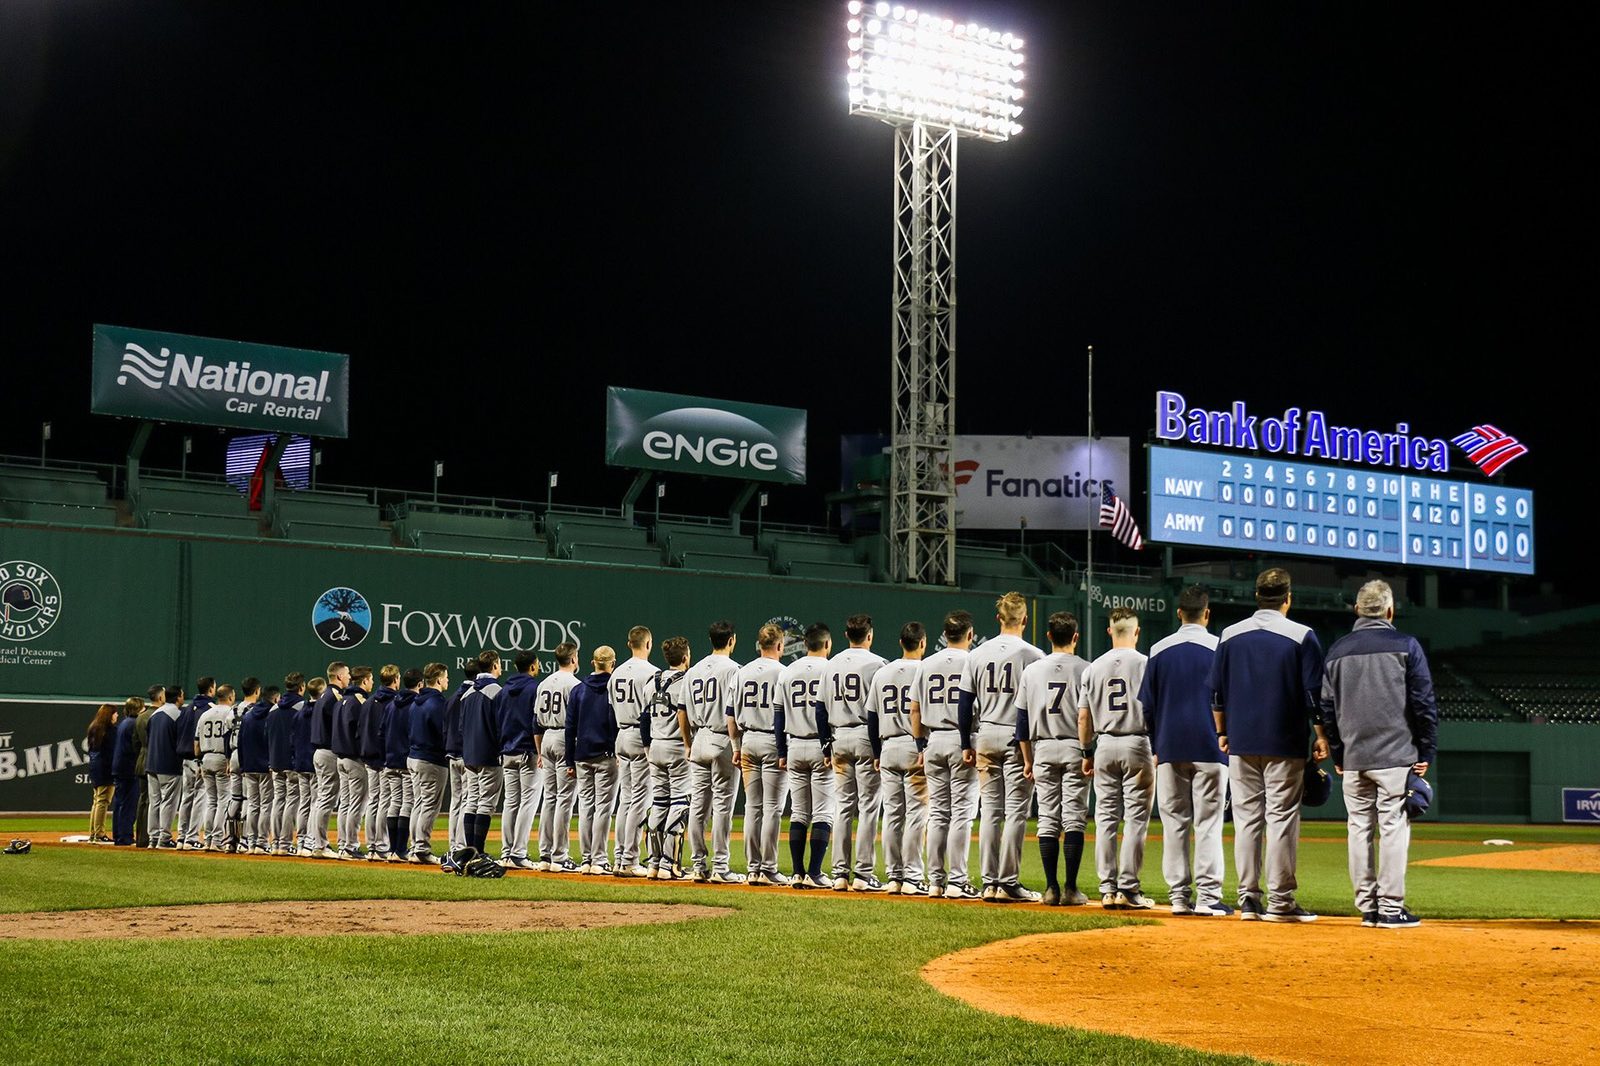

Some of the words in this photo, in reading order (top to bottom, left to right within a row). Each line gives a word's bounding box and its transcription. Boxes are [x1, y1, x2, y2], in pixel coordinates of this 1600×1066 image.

[169, 353, 329, 402] National
[225, 398, 258, 414] Car
[262, 401, 322, 421] Rental
[1156, 390, 1258, 449] Bank
[1261, 407, 1301, 455] of
[1303, 411, 1449, 473] America
[1222, 460, 1232, 477] 2
[1243, 463, 1253, 479] 3
[1264, 465, 1274, 482] 4
[1285, 467, 1294, 484] 5
[1306, 470, 1316, 486] 6
[1326, 472, 1336, 488] 7
[1346, 474, 1356, 491] 8
[1366, 476, 1376, 493] 9
[1383, 478, 1398, 495] 10
[1411, 481, 1421, 498] R
[1430, 483, 1440, 500] H
[1449, 485, 1459, 502] E
[1164, 477, 1203, 497] NAVY
[1222, 484, 1232, 501] 0
[1243, 486, 1253, 503] 0
[1264, 489, 1274, 506] 0
[1285, 491, 1295, 508] 0
[1308, 493, 1314, 510] 1
[1326, 495, 1336, 512] 2
[1347, 498, 1356, 514] 0
[1367, 500, 1376, 516] 0
[1412, 505, 1421, 521] 4
[1429, 507, 1442, 523] 12
[1450, 508, 1460, 525] 0
[1474, 493, 1486, 514] B
[1495, 495, 1507, 516] S
[1164, 512, 1205, 532] ARMY
[1222, 519, 1232, 536] 0
[1244, 521, 1254, 538] 0
[1265, 523, 1275, 540] 0
[1286, 525, 1295, 541] 0
[1307, 527, 1316, 543] 0
[1327, 529, 1337, 545] 0
[1347, 531, 1357, 547] 0
[1367, 533, 1377, 549] 0
[1412, 537, 1422, 553] 0
[1432, 539, 1441, 555] 3
[1452, 541, 1457, 557] 1
[1474, 528, 1486, 553] 0
[1495, 530, 1508, 555] 0
[1516, 533, 1529, 557] 0
[16, 564, 49, 586] SOX
[1102, 595, 1166, 613] ABIOMED
[380, 603, 582, 653] FOXWOODS
[21, 647, 66, 656] Deaconess
[22, 656, 53, 665] Center
[615, 678, 635, 703] 51
[692, 677, 717, 705] 20
[832, 673, 861, 702] 19
[928, 674, 962, 704] 22
[986, 662, 1014, 693] 11
[539, 690, 562, 715] 38
[744, 681, 770, 708] 21
[1048, 682, 1067, 714] 7
[1107, 678, 1127, 711] 2
[204, 720, 222, 738] 33
